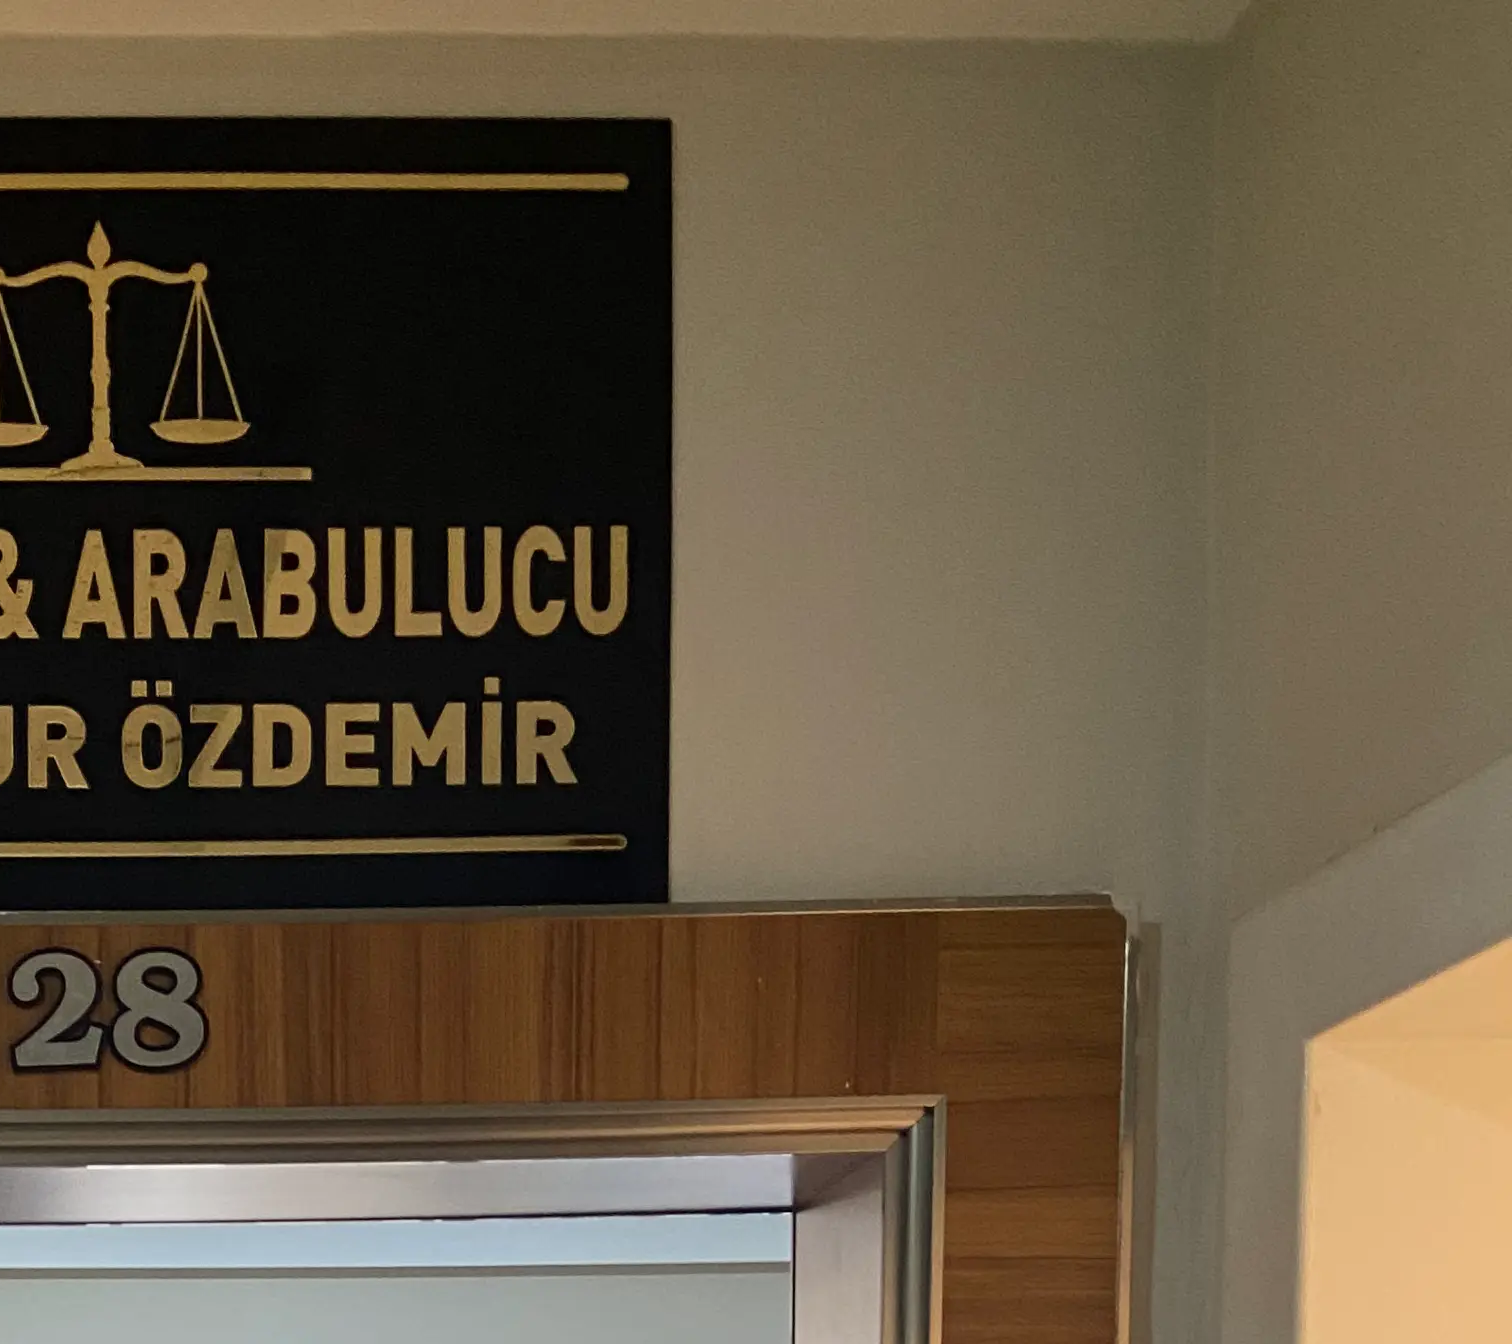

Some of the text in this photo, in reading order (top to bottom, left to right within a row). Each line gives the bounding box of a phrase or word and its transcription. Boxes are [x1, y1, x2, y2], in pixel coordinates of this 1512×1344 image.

[62, 525, 629, 640] ARABULUCU
[121, 677, 578, 789] ÖZDEMİR
[8, 948, 207, 1072] 28
